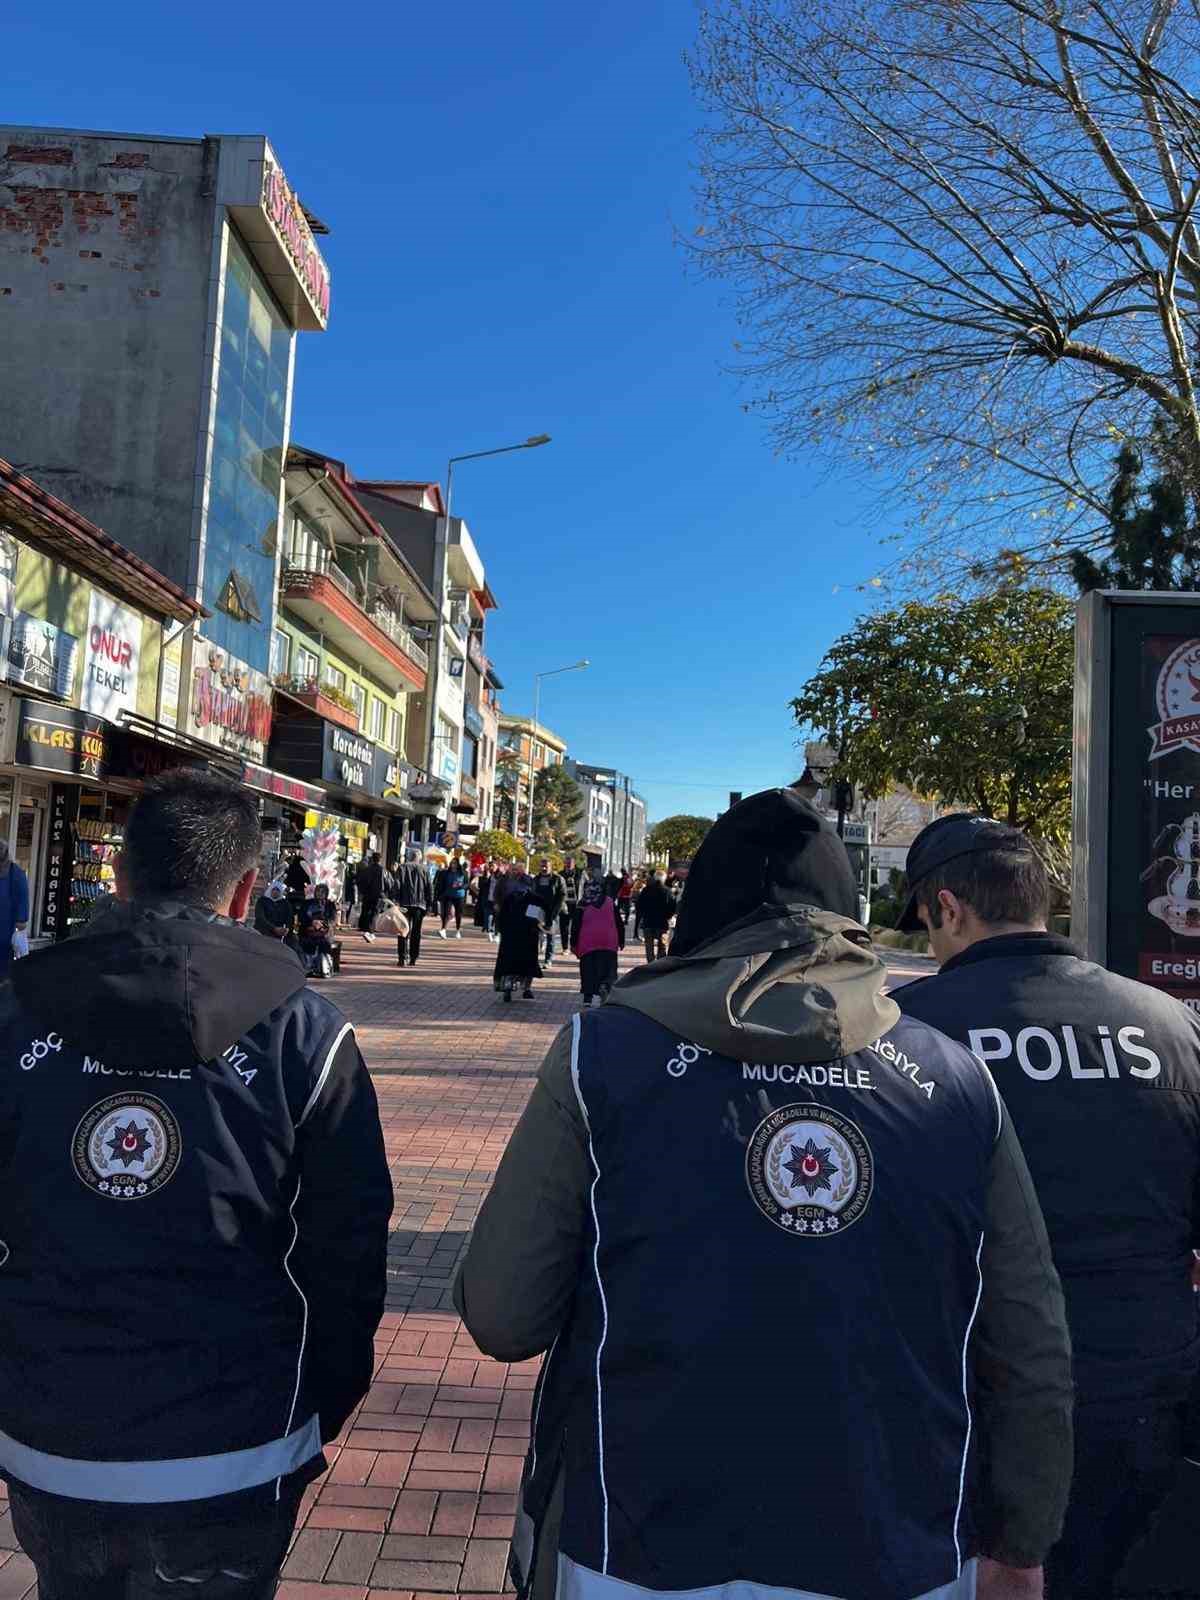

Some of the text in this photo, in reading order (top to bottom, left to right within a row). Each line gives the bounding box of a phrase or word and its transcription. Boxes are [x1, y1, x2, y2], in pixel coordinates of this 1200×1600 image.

[90, 624, 132, 670] ONUR
[89, 662, 127, 694] TEKEL
[342, 760, 364, 786] Optik
[54, 795, 64, 841] KLAS
[20, 1032, 63, 1070] GÖÇ
[112, 1174, 136, 1185] EGM
[797, 1206, 825, 1218] EGM
